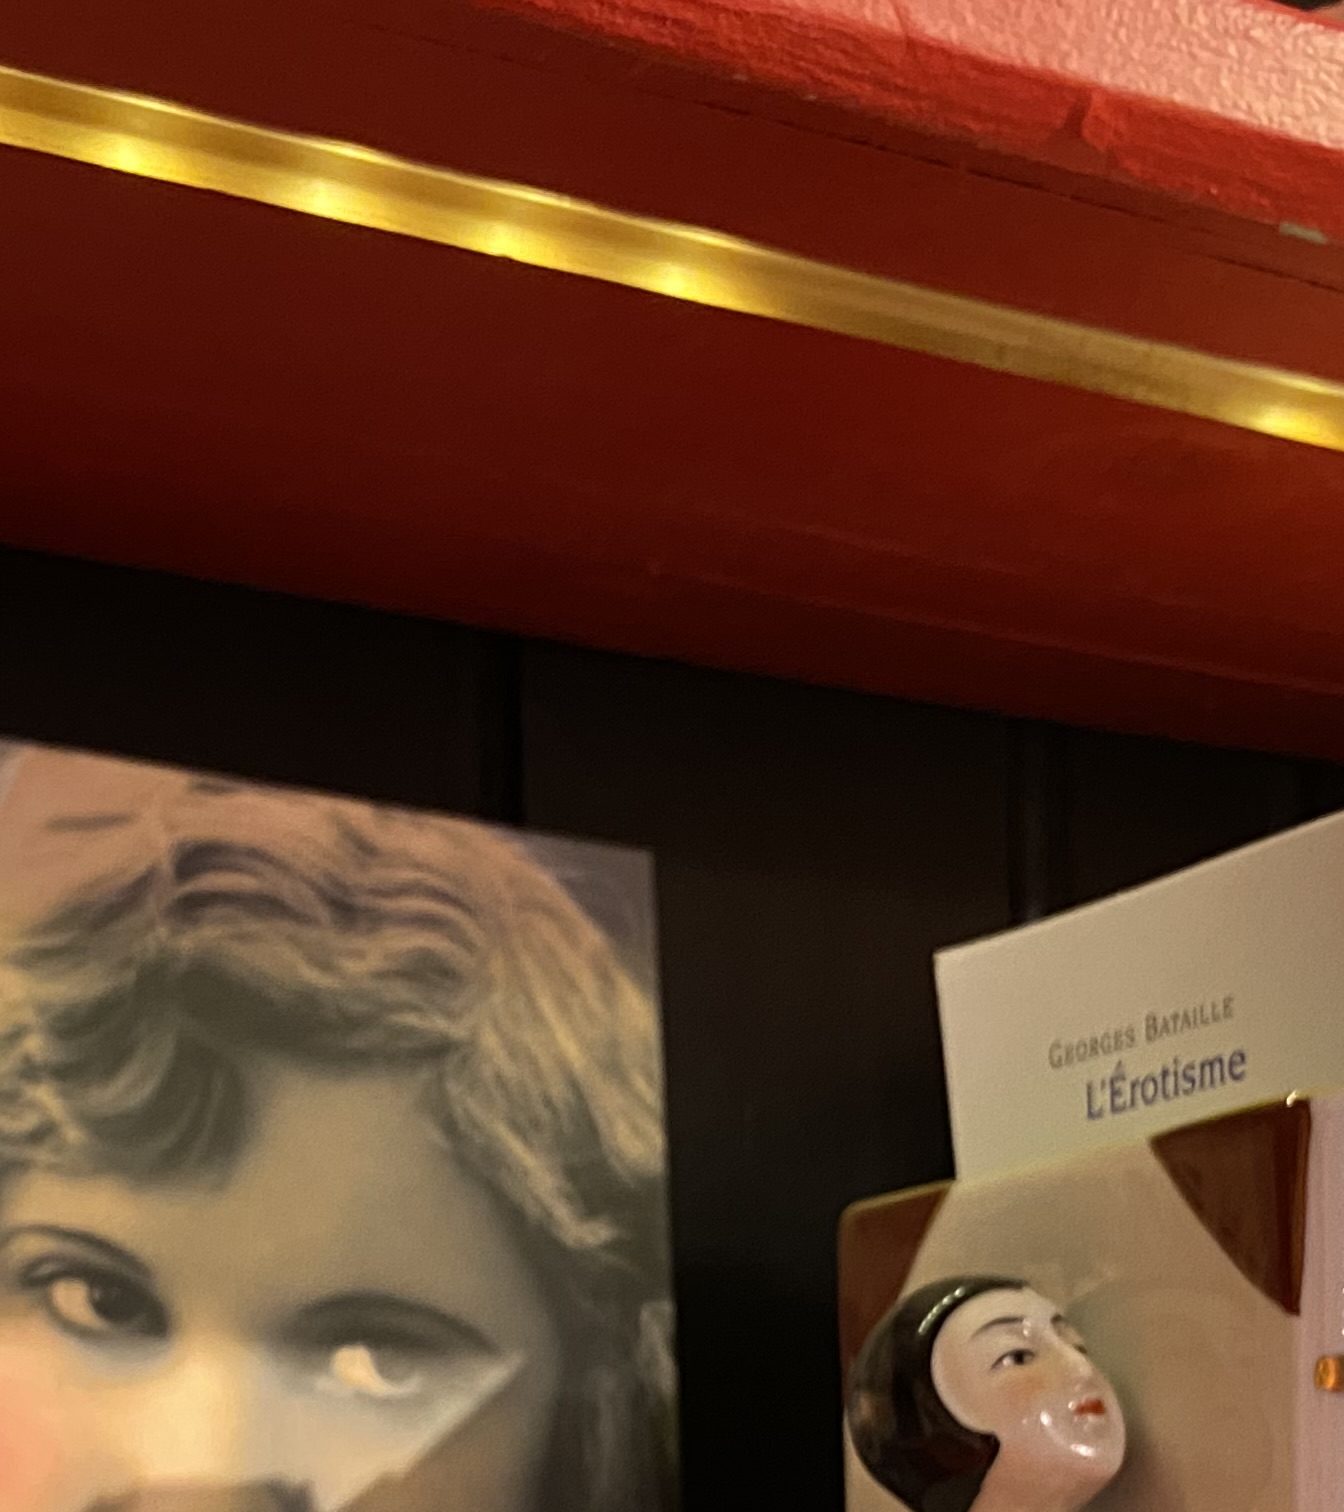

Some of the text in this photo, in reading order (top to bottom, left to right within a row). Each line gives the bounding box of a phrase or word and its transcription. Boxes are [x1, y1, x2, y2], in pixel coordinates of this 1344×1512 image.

[1048, 995, 1236, 1070] GEORGES BATAILLE
[1085, 1048, 1248, 1121] L'Érotisme
